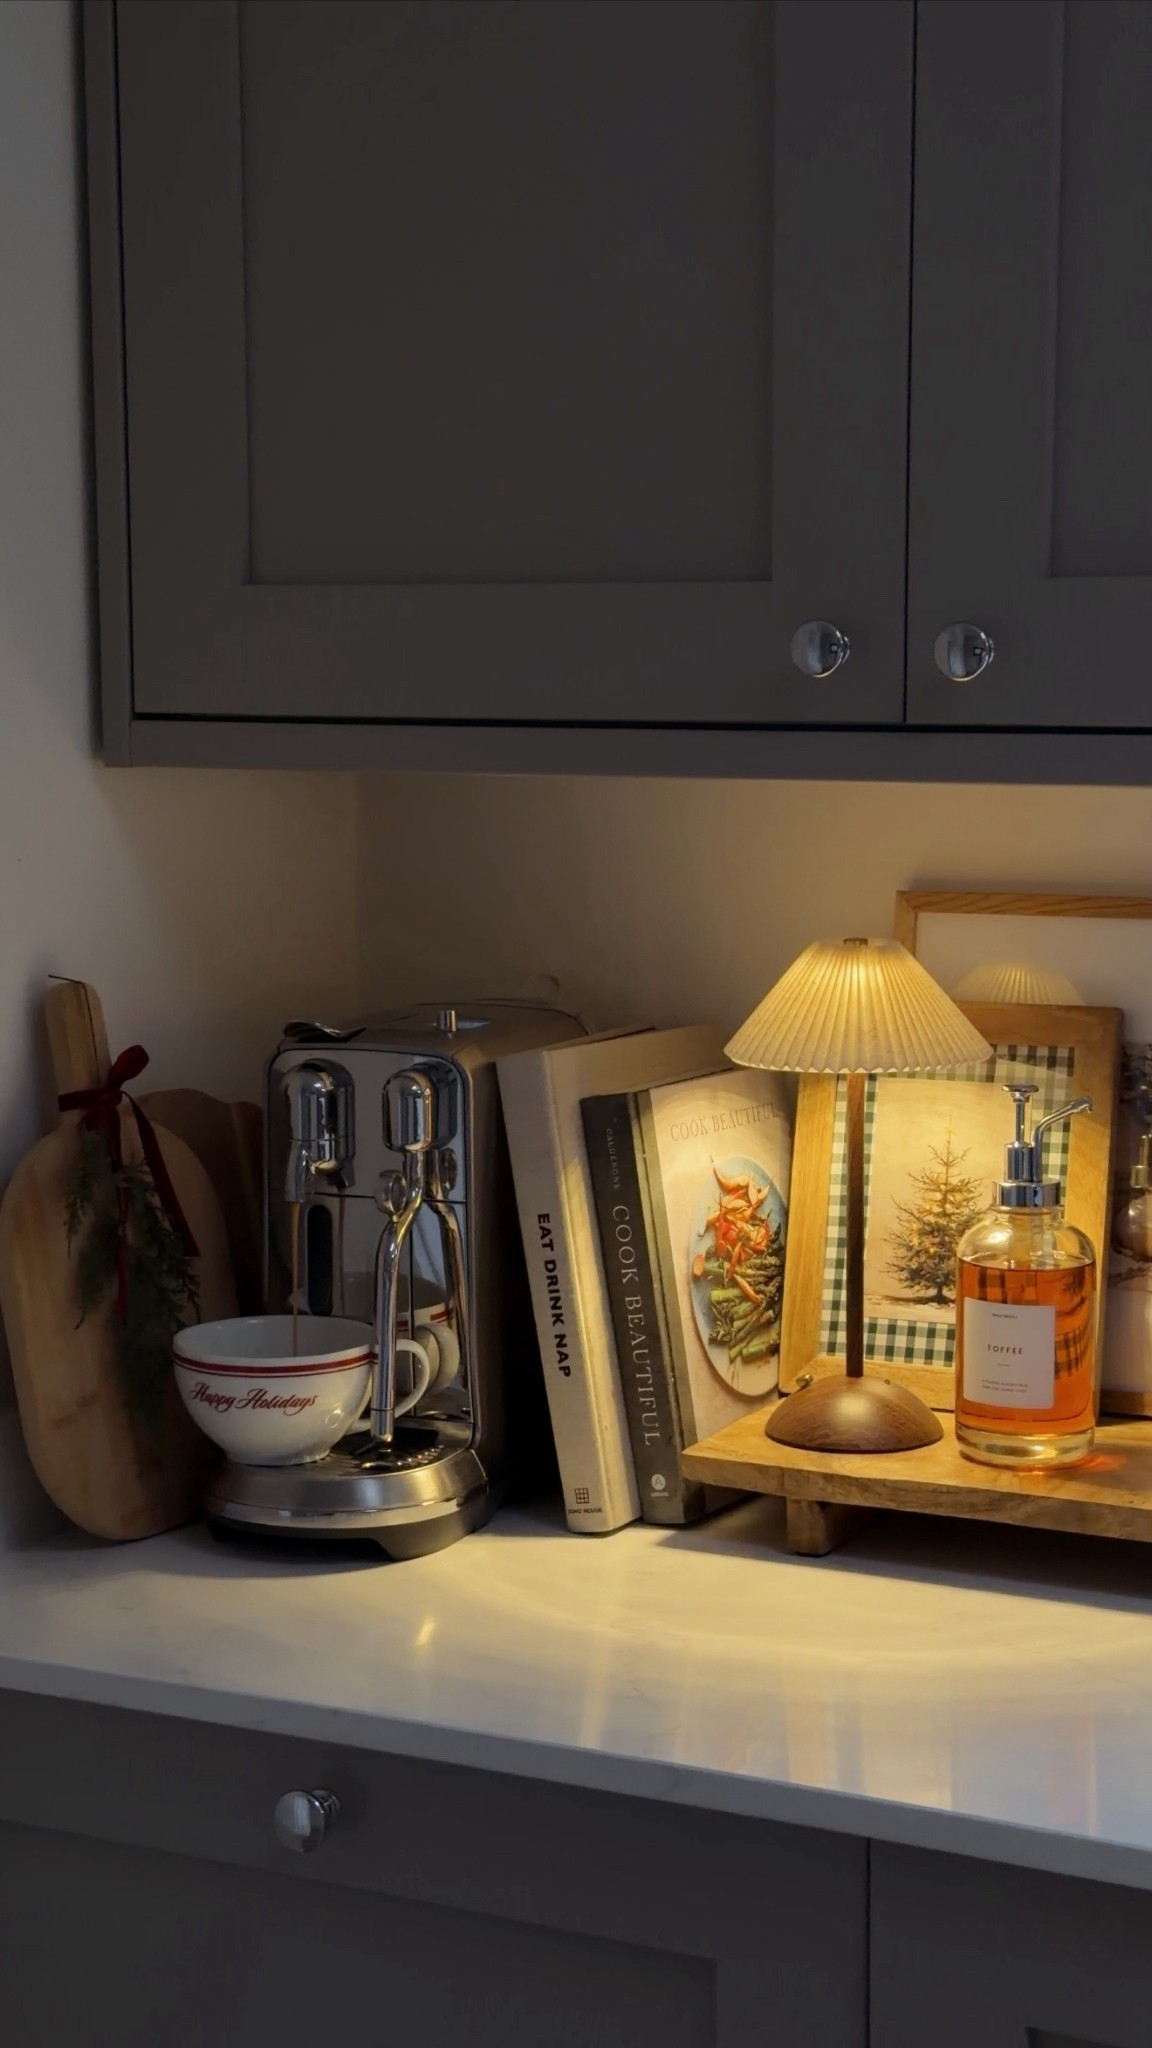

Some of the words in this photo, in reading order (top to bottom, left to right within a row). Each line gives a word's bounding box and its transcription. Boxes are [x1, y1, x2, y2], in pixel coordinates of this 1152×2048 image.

[670, 1117, 708, 1142] COOK
[711, 1102, 779, 1132] BEAUTIFUL
[537, 1213, 554, 1252] EAT
[612, 1205, 639, 1284] COOK
[544, 1259, 565, 1327] DRINK
[554, 1333, 571, 1378] NAP
[987, 1344, 1023, 1355] TOFFEE
[624, 1296, 661, 1446] BEAUTIFUL
[191, 1382, 236, 1413] Happy
[235, 1388, 318, 1416] Holidays
